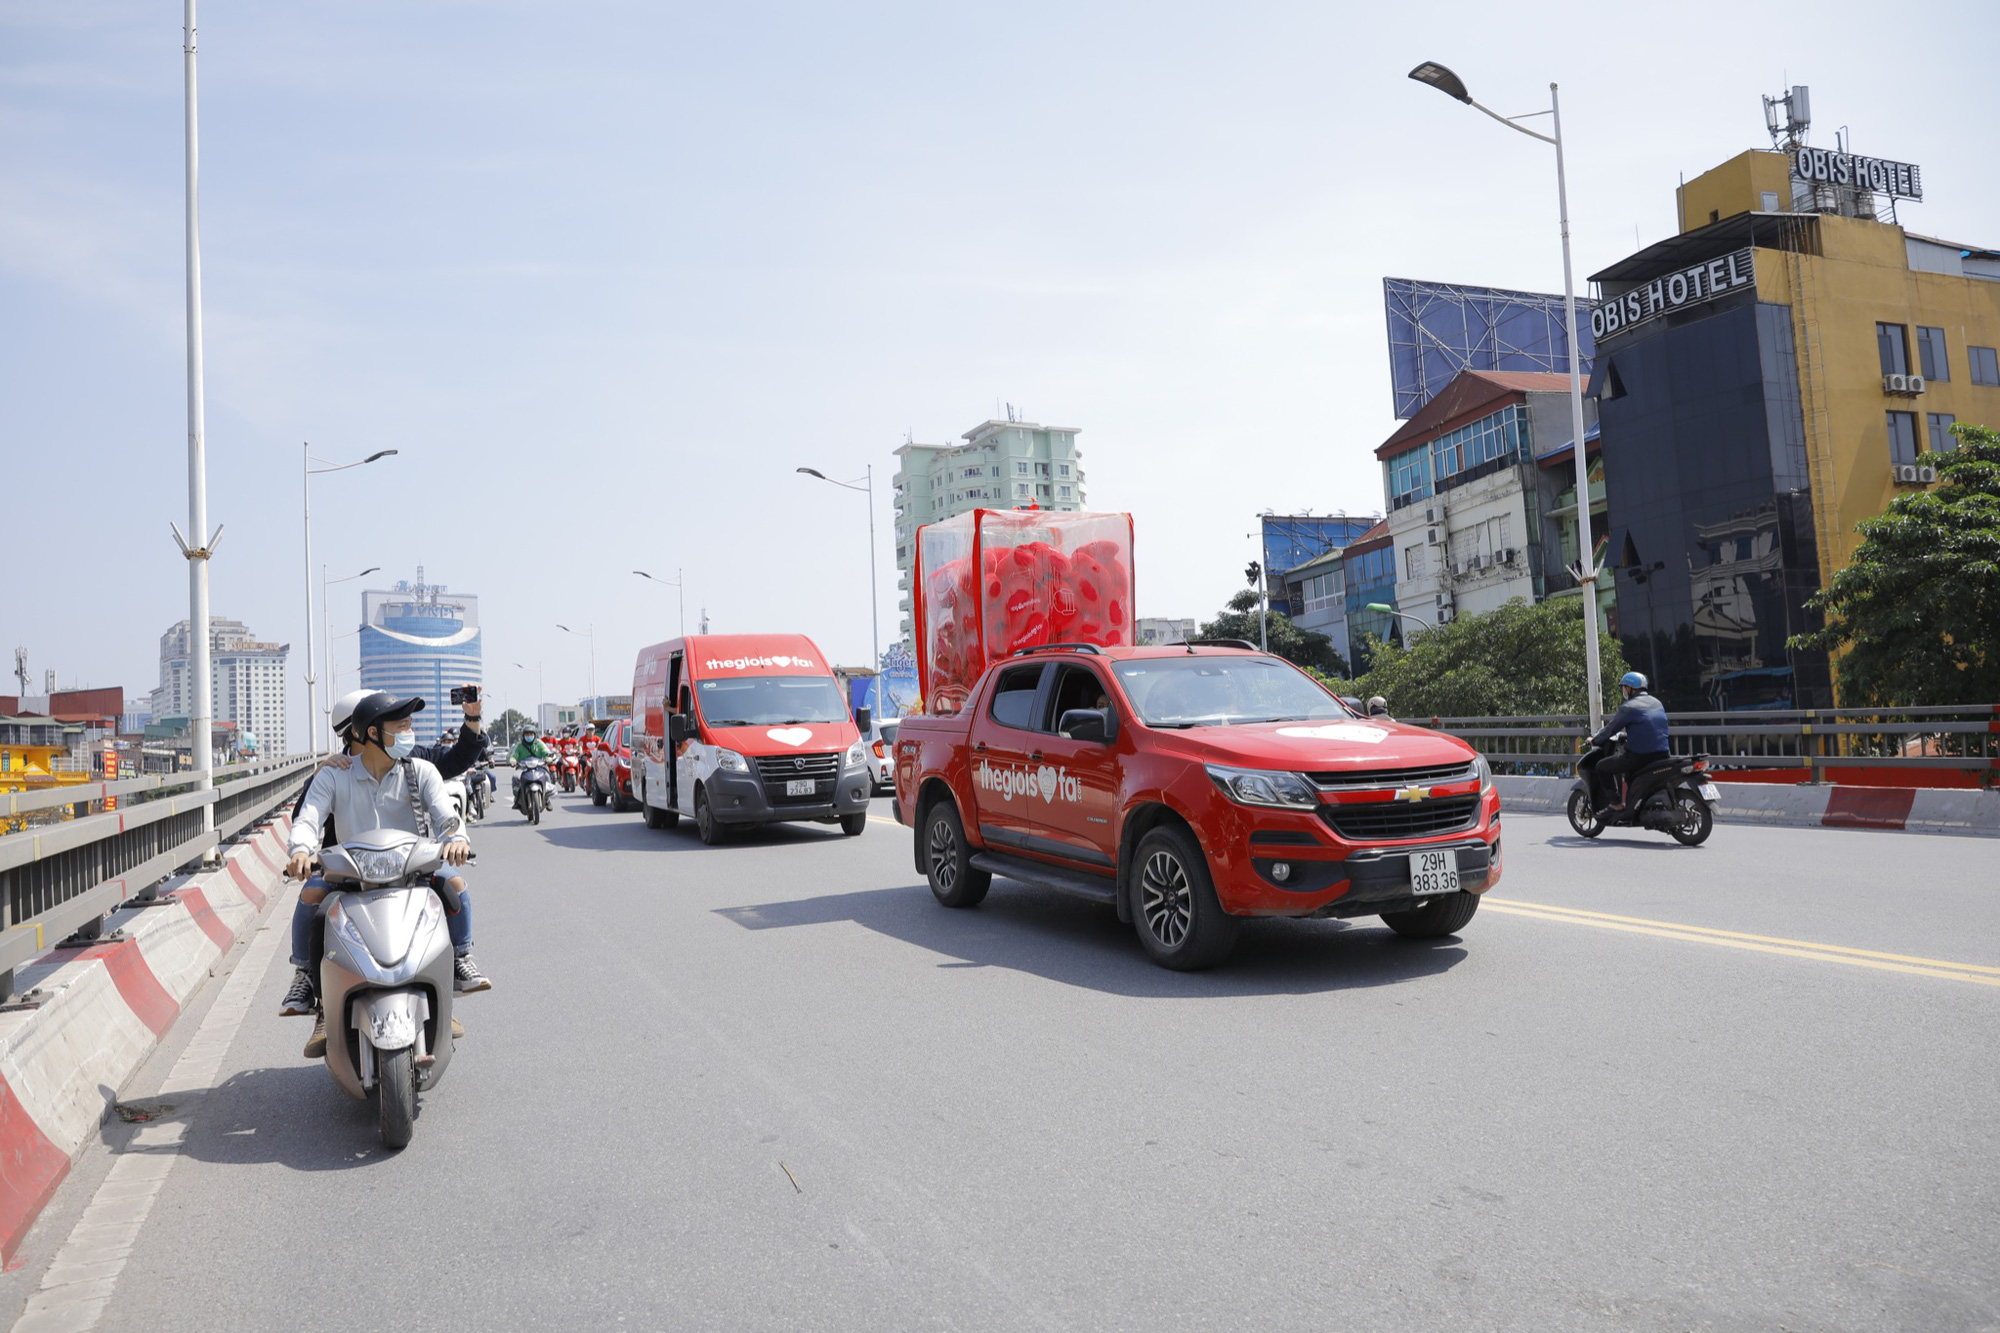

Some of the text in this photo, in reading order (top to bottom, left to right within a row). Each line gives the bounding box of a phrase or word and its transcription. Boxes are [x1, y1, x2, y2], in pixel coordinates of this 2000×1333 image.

[1796, 147, 1922, 198] OBIS HOTEL
[1591, 254, 1748, 338] OBIS HOTEL
[889, 656, 915, 672] Tiger
[979, 758, 1038, 802] thegiois
[1420, 852, 1447, 872] 29H
[1413, 871, 1458, 892] 383.36
